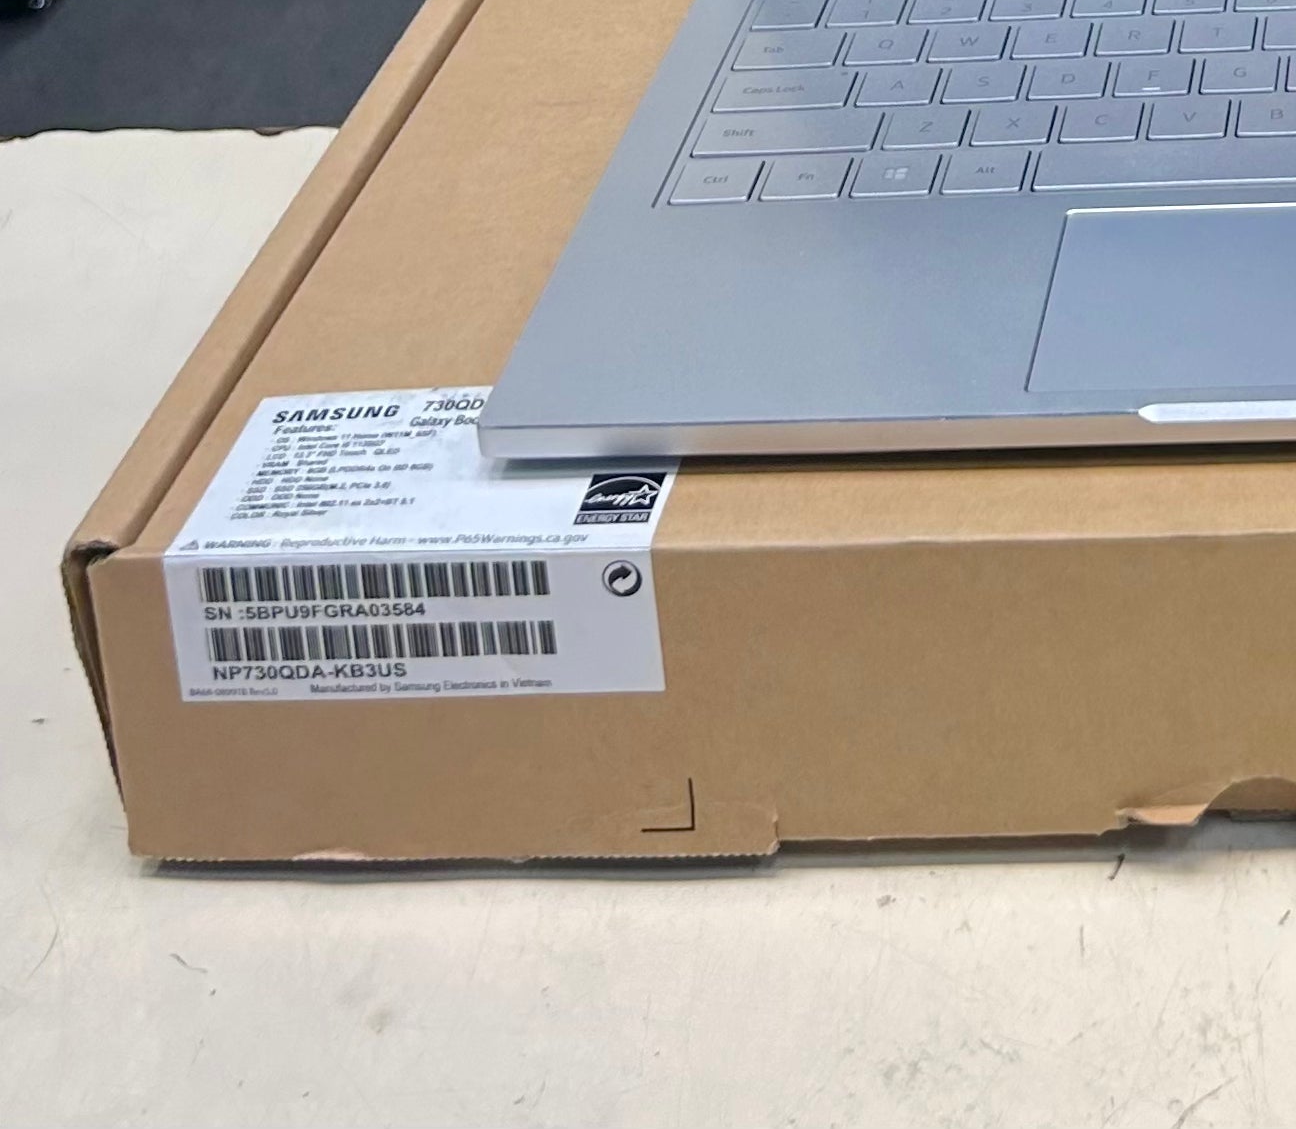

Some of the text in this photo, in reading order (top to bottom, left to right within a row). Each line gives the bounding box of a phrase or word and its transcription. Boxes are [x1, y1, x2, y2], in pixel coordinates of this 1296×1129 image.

[1045, 33, 1057, 43] E
[1127, 30, 1141, 40] R
[960, 36, 980, 46] W
[1147, 70, 1159, 81] F
[1233, 67, 1247, 77] G
[976, 76, 990, 87] S
[1061, 73, 1076, 84] D
[890, 80, 904, 90] A
[1095, 114, 1108, 125] C
[1183, 112, 1197, 122] V
[1270, 109, 1284, 119] B
[919, 122, 933, 133] Z
[1005, 118, 1021, 128] X
[703, 175, 728, 184] Ctrl
[272, 399, 485, 423] SAMSUNG 730QD
[410, 415, 452, 428] Galaxy
[576, 512, 648, 523] ENERGY STAR
[281, 537, 367, 549] Reproductive
[369, 536, 406, 545] Harm
[418, 533, 589, 546] www.P65Warnings.ca.gov
[205, 607, 231, 620] SN
[212, 662, 407, 680] NP730QDA-KB3US
[379, 683, 391, 693] by
